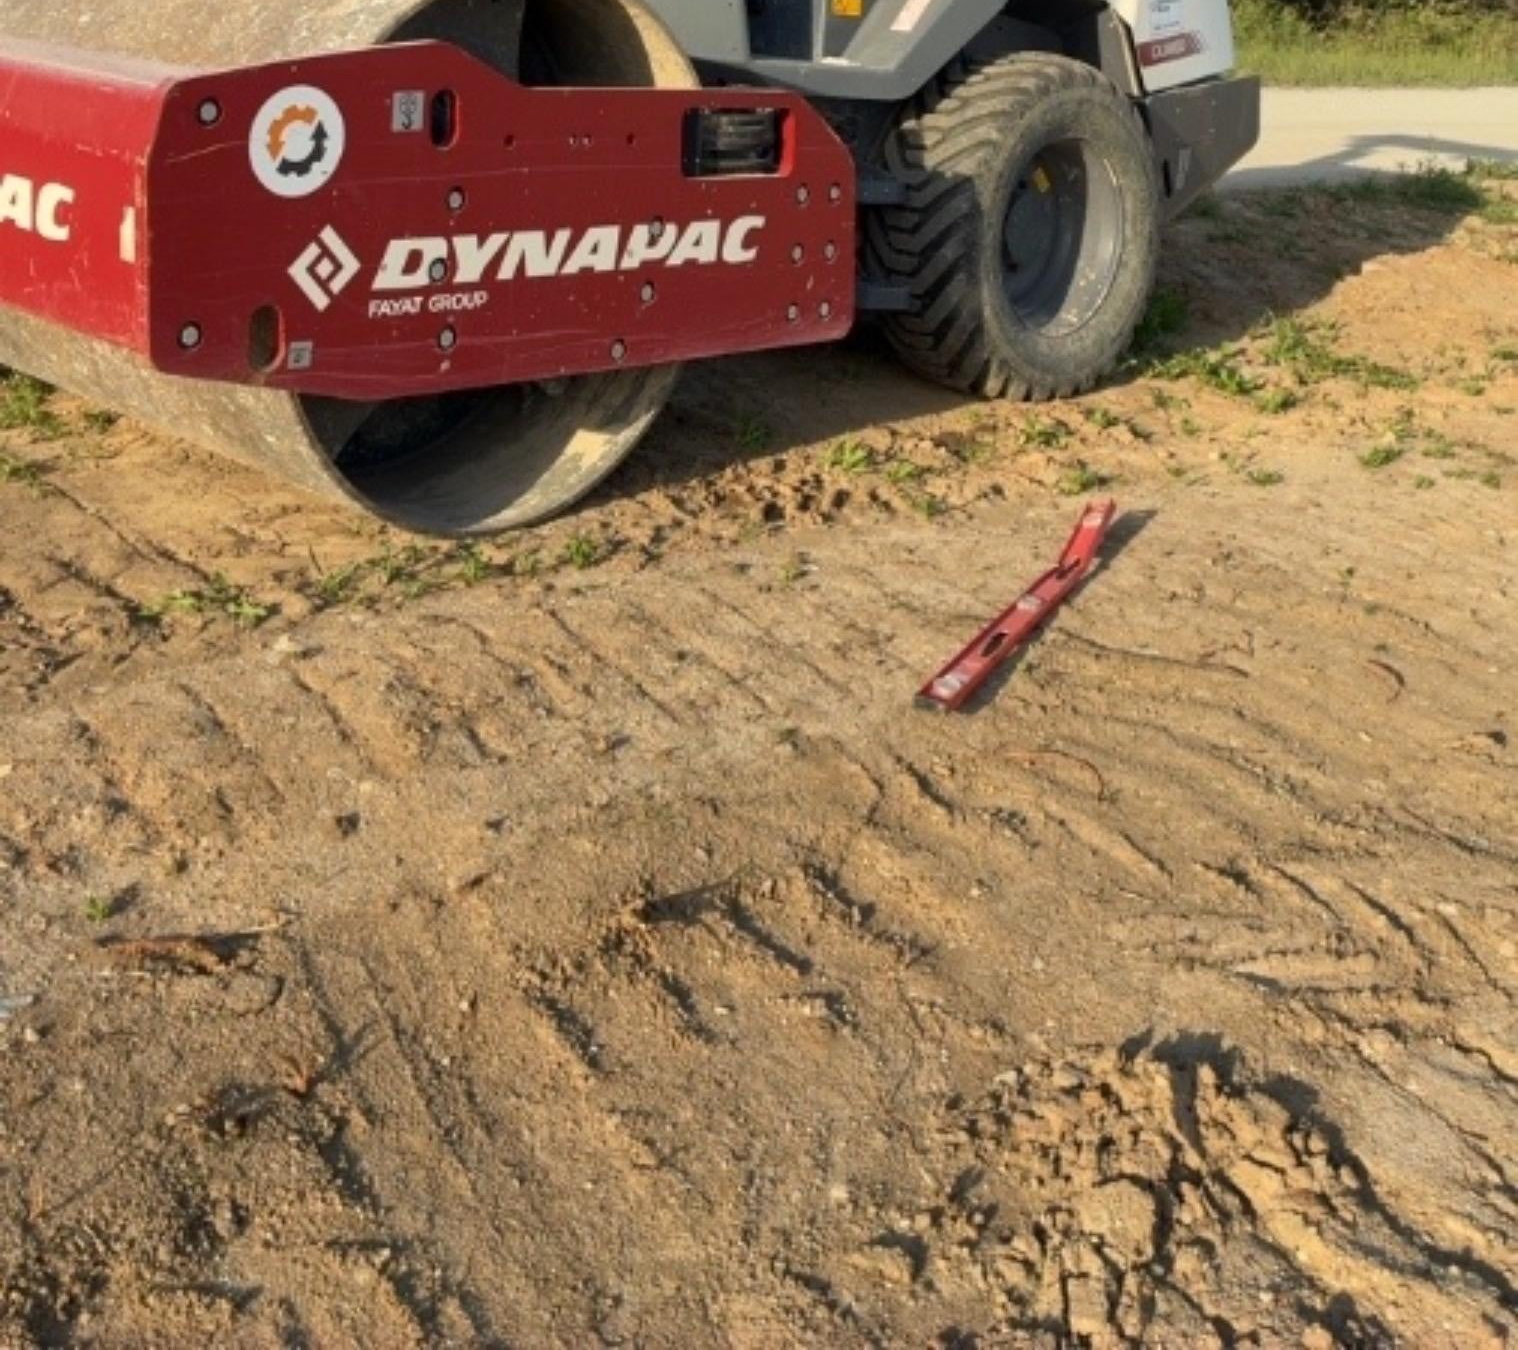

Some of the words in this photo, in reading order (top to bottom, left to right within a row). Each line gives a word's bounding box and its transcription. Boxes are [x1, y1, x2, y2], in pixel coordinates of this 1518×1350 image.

[371, 215, 766, 291] DYNAPAC
[368, 295, 424, 318] FAYAT
[428, 290, 488, 313] GROUP
